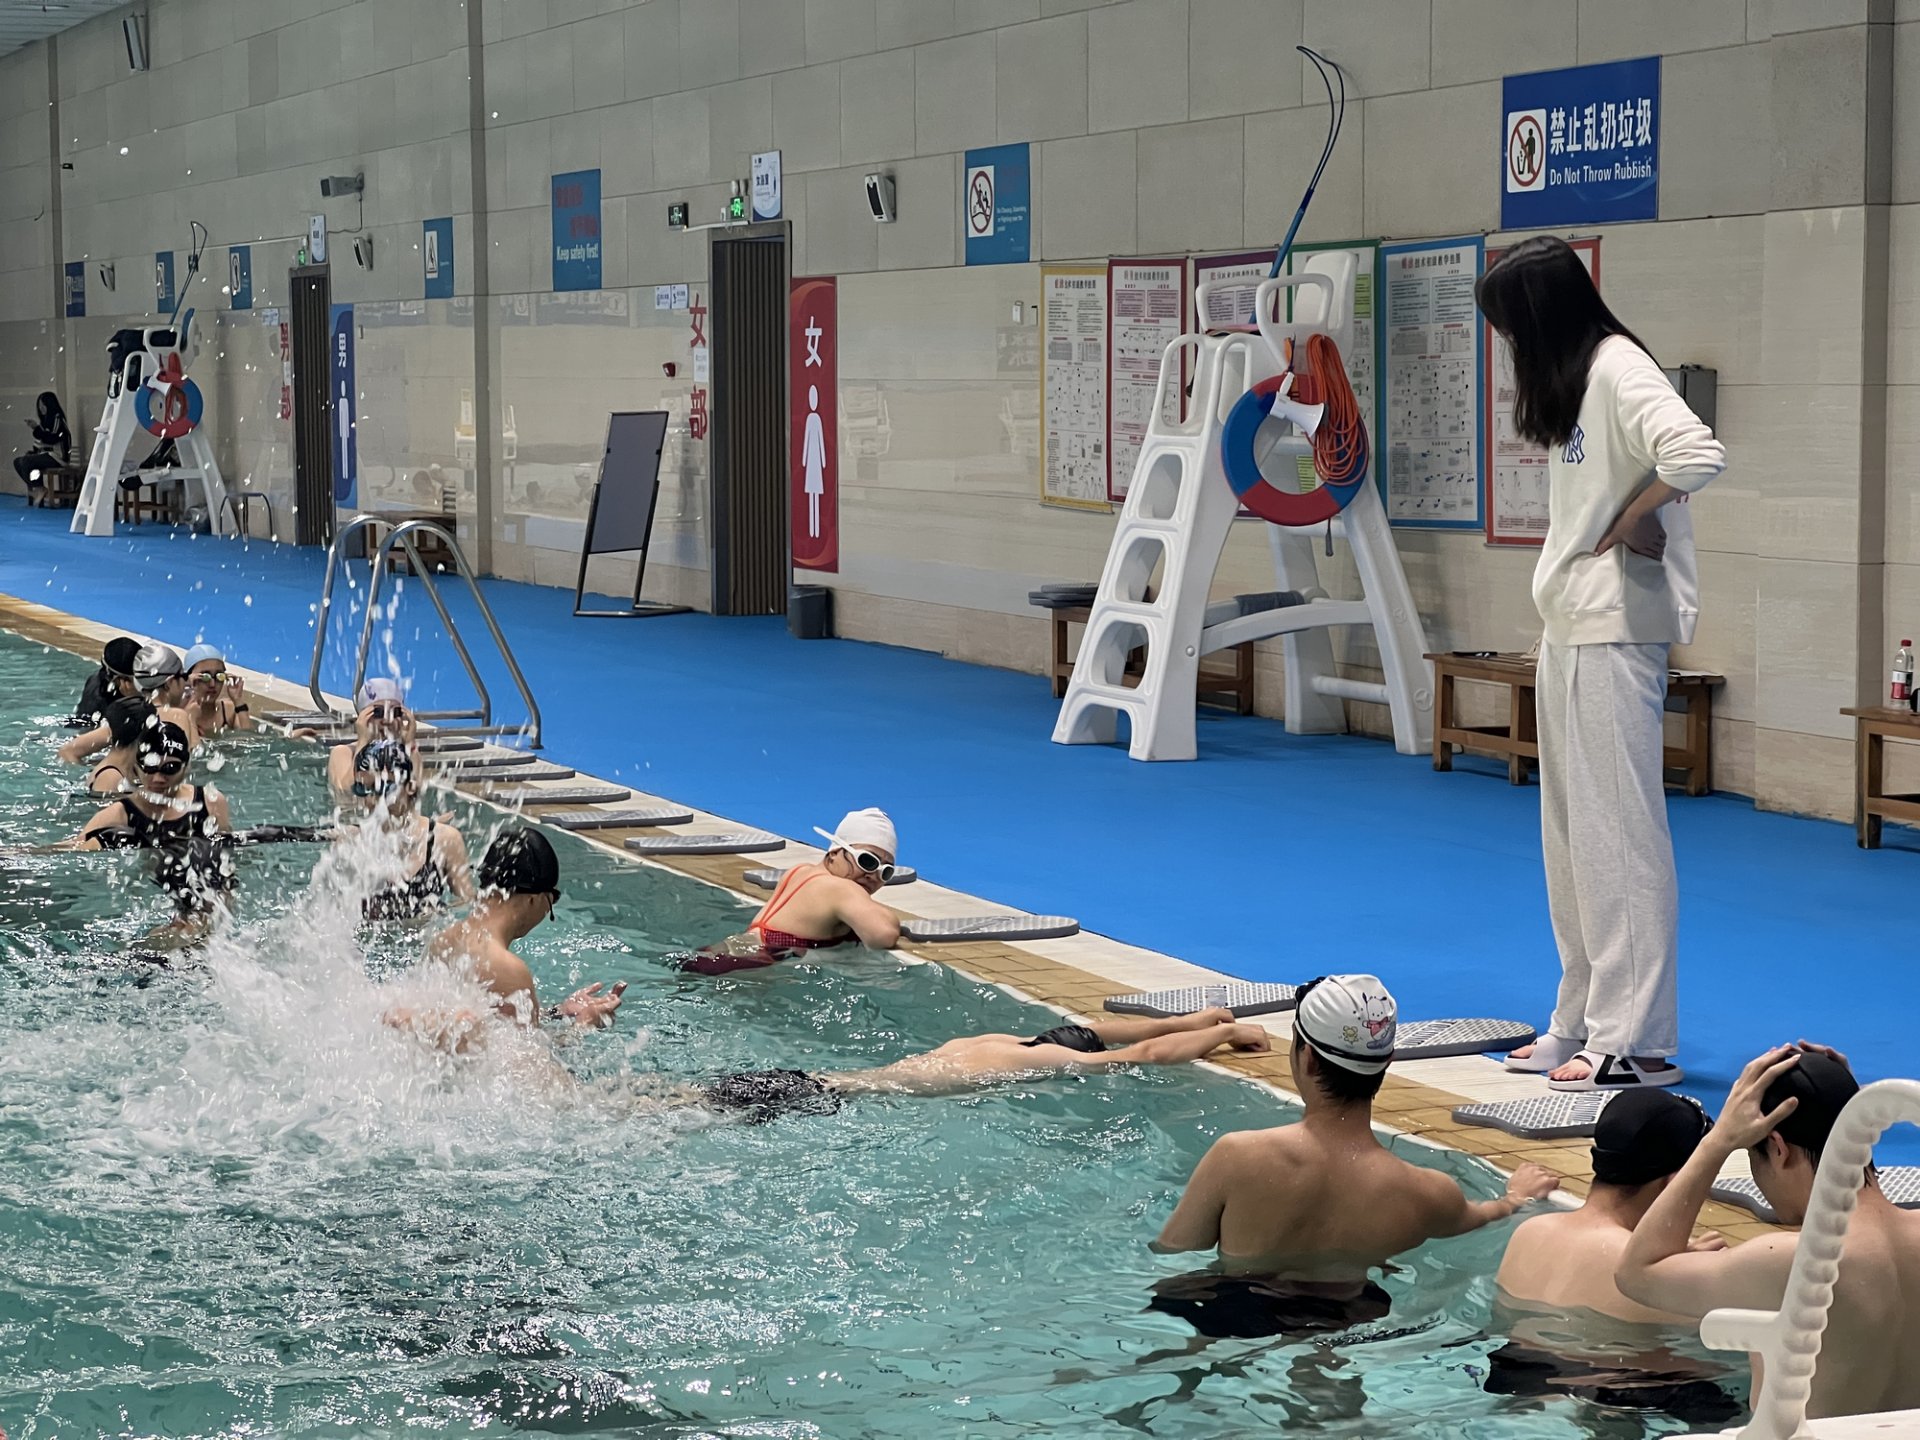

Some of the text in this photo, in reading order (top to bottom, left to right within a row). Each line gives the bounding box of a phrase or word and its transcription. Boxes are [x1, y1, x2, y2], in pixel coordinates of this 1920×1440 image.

[1550, 97, 1652, 156] 禁止乱扔垃圾
[1550, 161, 1652, 185] Do Not Throw Rubbish
[338, 333, 347, 368] 男
[805, 315, 822, 368] 女
